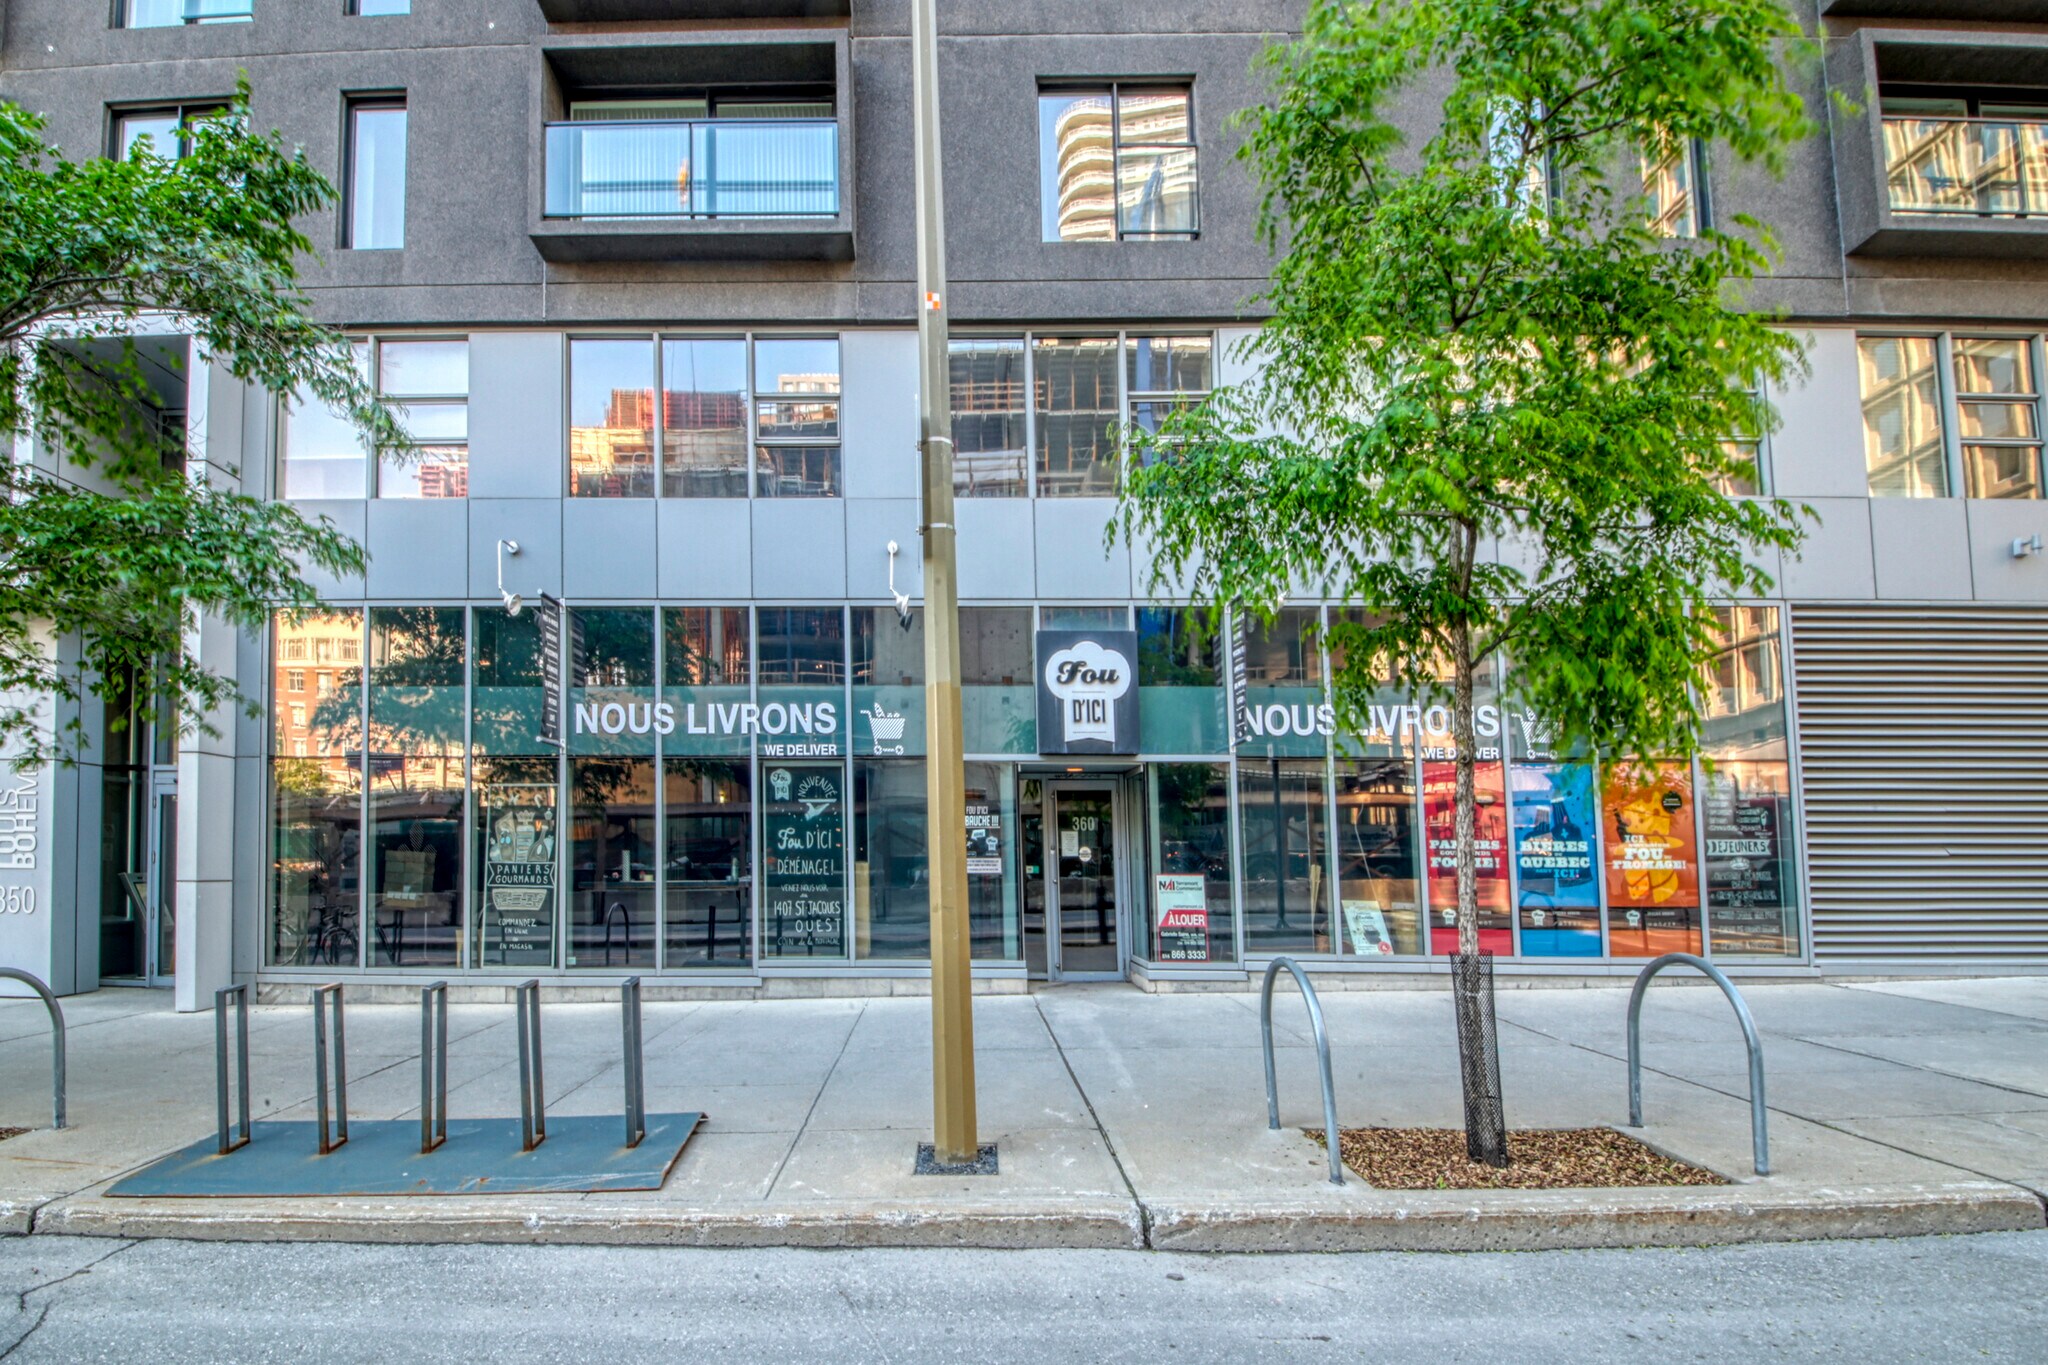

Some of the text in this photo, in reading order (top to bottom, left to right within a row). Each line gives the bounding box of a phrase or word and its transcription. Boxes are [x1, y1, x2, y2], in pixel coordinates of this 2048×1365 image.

[1056, 660, 1120, 685] Fou
[1073, 699, 1106, 723] D'ICI
[575, 703, 837, 734] NOUS LIVRONS
[1246, 704, 1500, 737] NOUS LIVROS
[764, 744, 837, 756] WE DELIVER
[1424, 747, 1499, 759] WE DVER
[966, 806, 976, 814] FOU
[965, 815, 990, 826] BAUCHE
[1072, 816, 1095, 831] 360
[778, 827, 832, 850] Fou D'ICI
[1624, 848, 1664, 860] FOU
[497, 864, 550, 875] PANIERS
[777, 856, 834, 876] DÉMÉNAGE!
[1613, 861, 1686, 869] FROMAGE!
[495, 874, 549, 885] GOURMANDS
[1158, 880, 1175, 890] NAI
[774, 901, 792, 916] 1407
[498, 918, 537, 927] COMMANDEZ
[795, 918, 841, 933] OUEST
[1176, 914, 1205, 925] LOUER
[1171, 950, 1185, 959] 866
[1187, 950, 1206, 959] 3333
